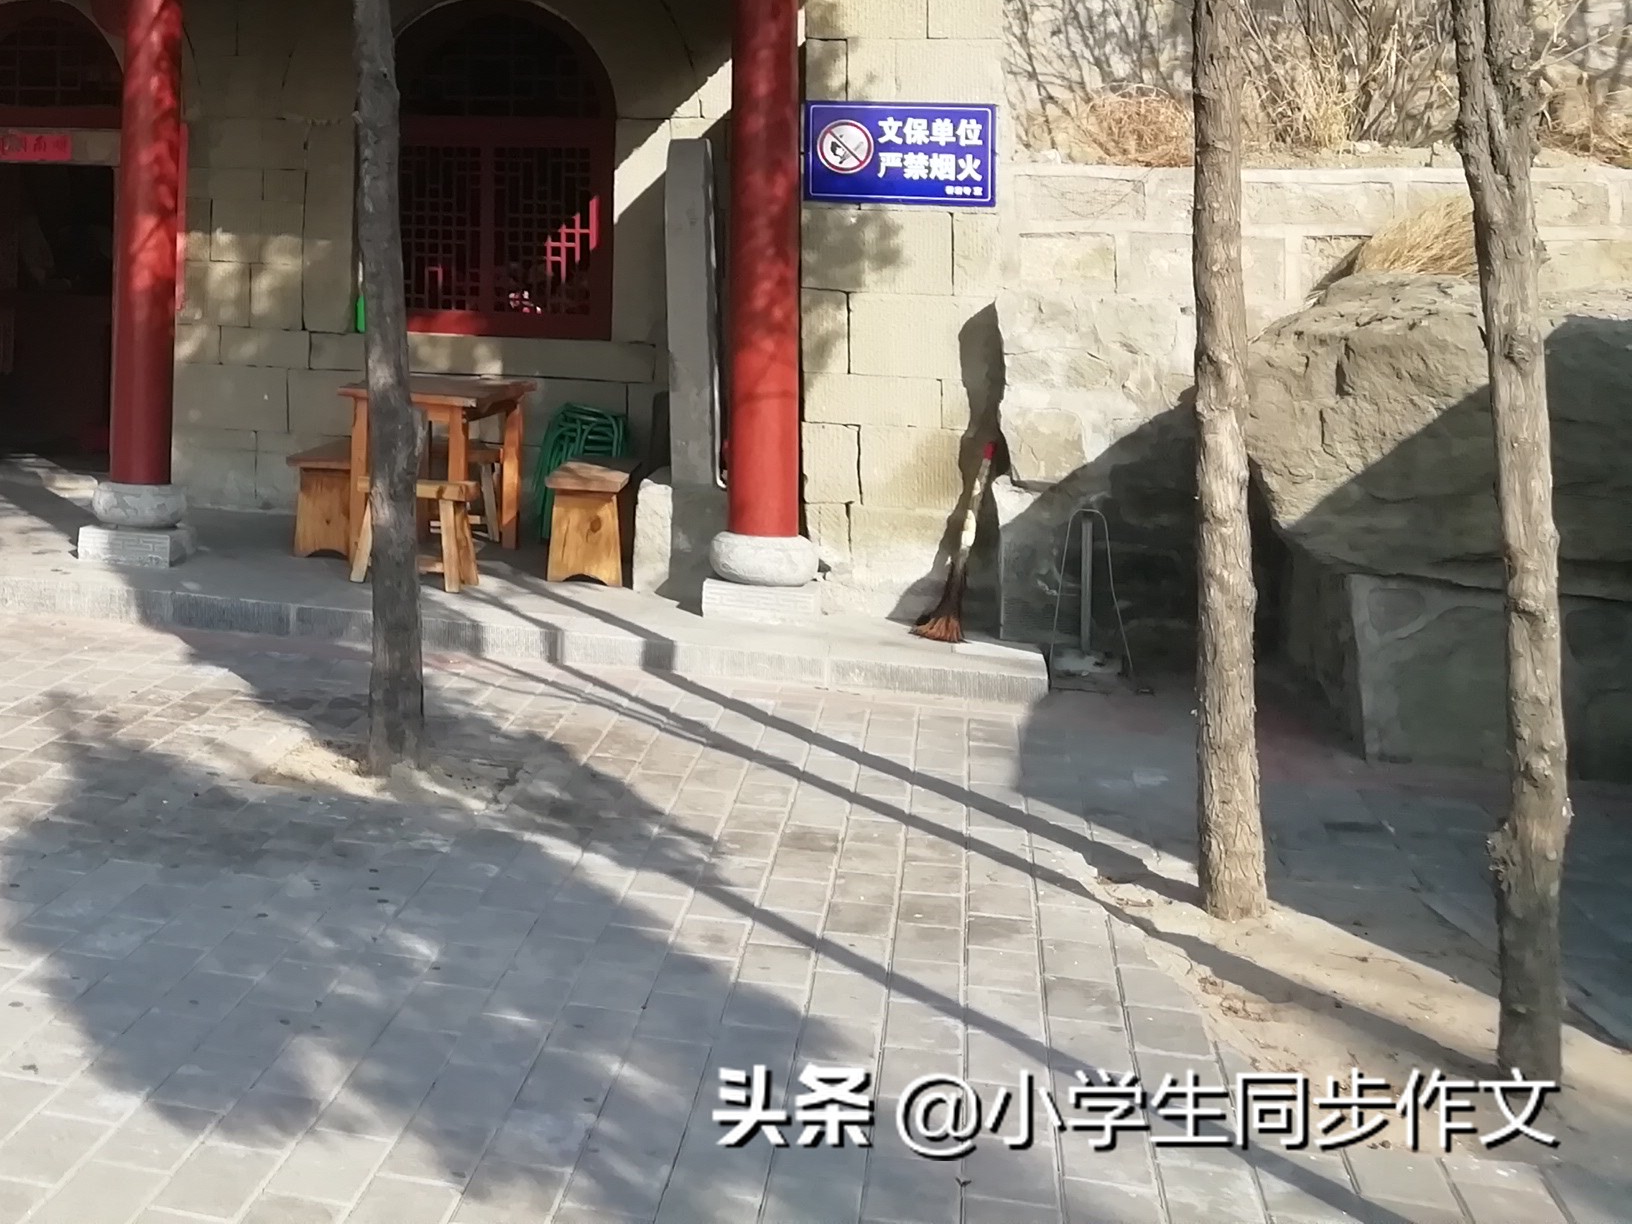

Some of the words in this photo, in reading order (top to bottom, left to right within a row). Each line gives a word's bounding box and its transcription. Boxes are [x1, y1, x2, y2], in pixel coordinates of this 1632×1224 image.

[878, 117, 983, 146] 文保单位
[877, 152, 983, 181] 严禁烟火
